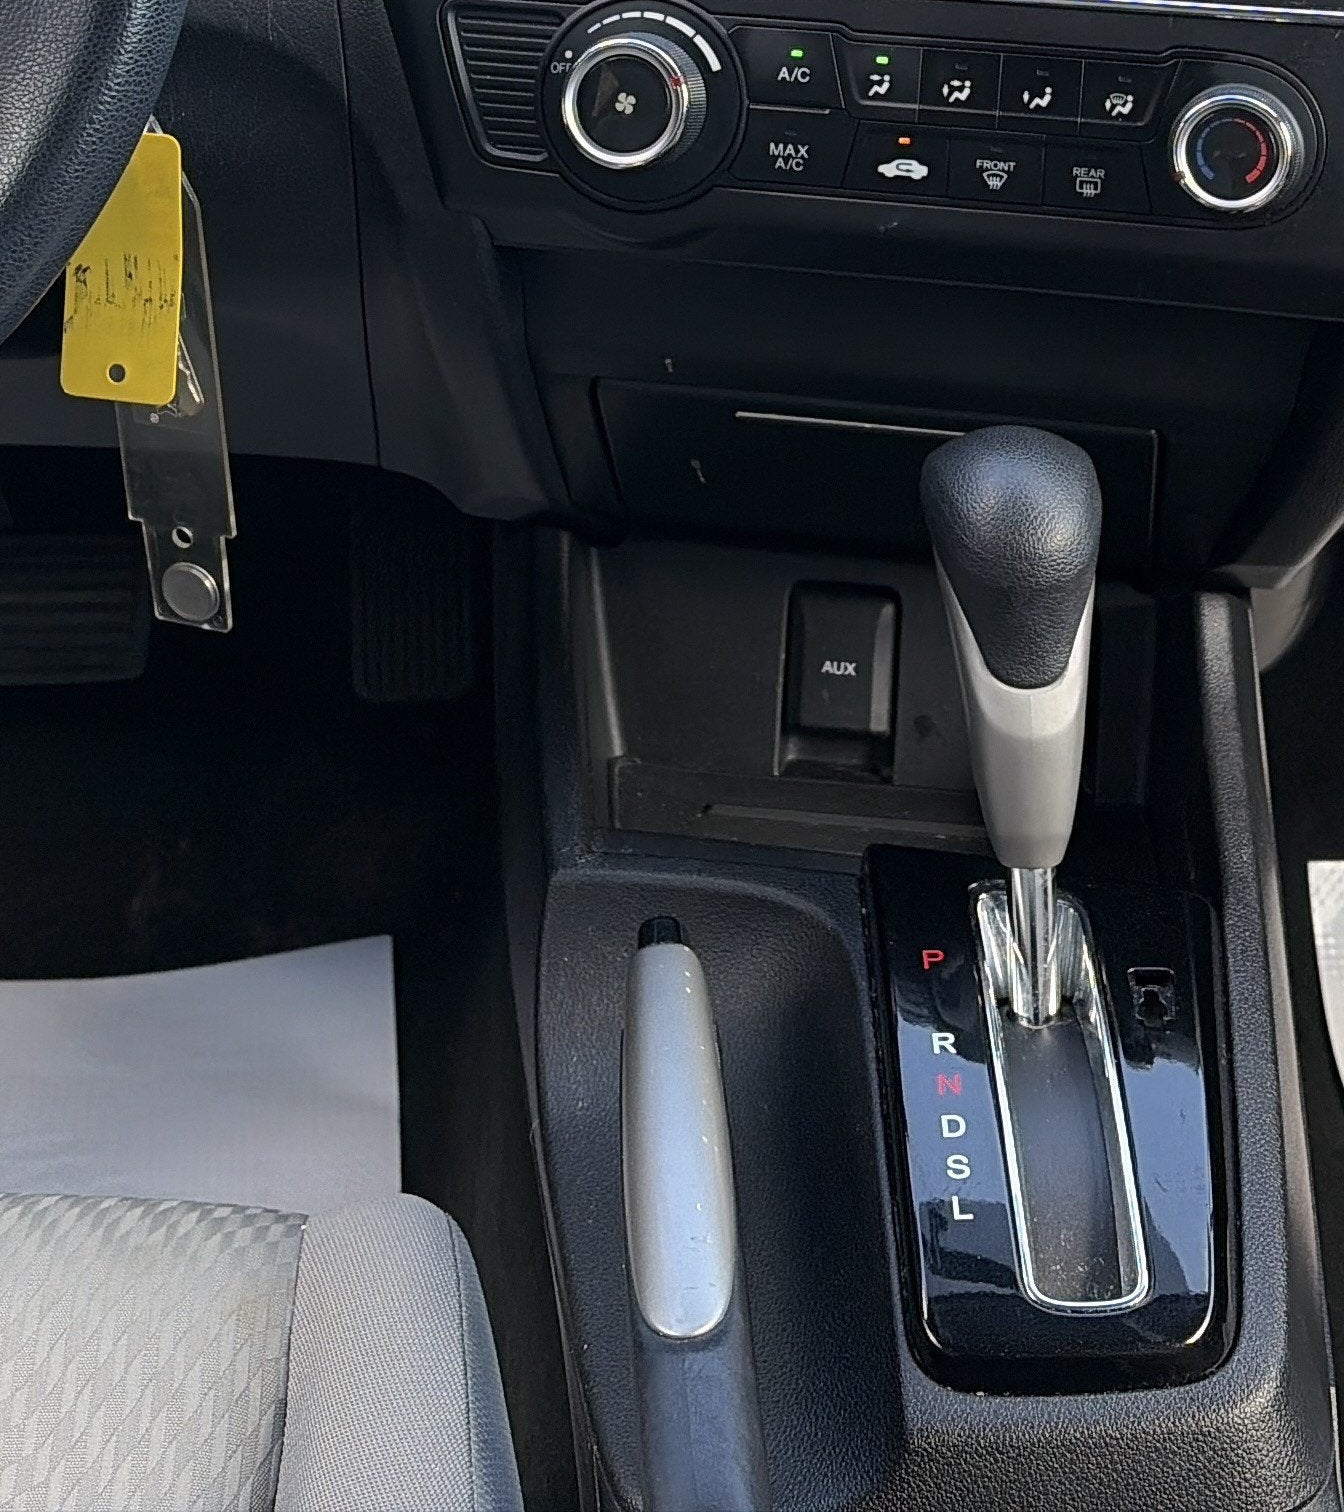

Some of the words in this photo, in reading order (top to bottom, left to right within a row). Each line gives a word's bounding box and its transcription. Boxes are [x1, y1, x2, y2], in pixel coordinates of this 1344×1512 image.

[777, 66, 811, 83] A/C
[769, 142, 809, 158] MAX
[775, 157, 804, 172] A/C
[976, 159, 1016, 172] FRONT
[1073, 166, 1105, 179] REAR
[821, 660, 857, 676] AUX
[922, 949, 944, 970] P
[931, 1032, 957, 1054] R
[937, 1073, 961, 1096] N
[940, 1114, 966, 1138] D
[946, 1154, 971, 1180] S
[951, 1195, 974, 1220] L
